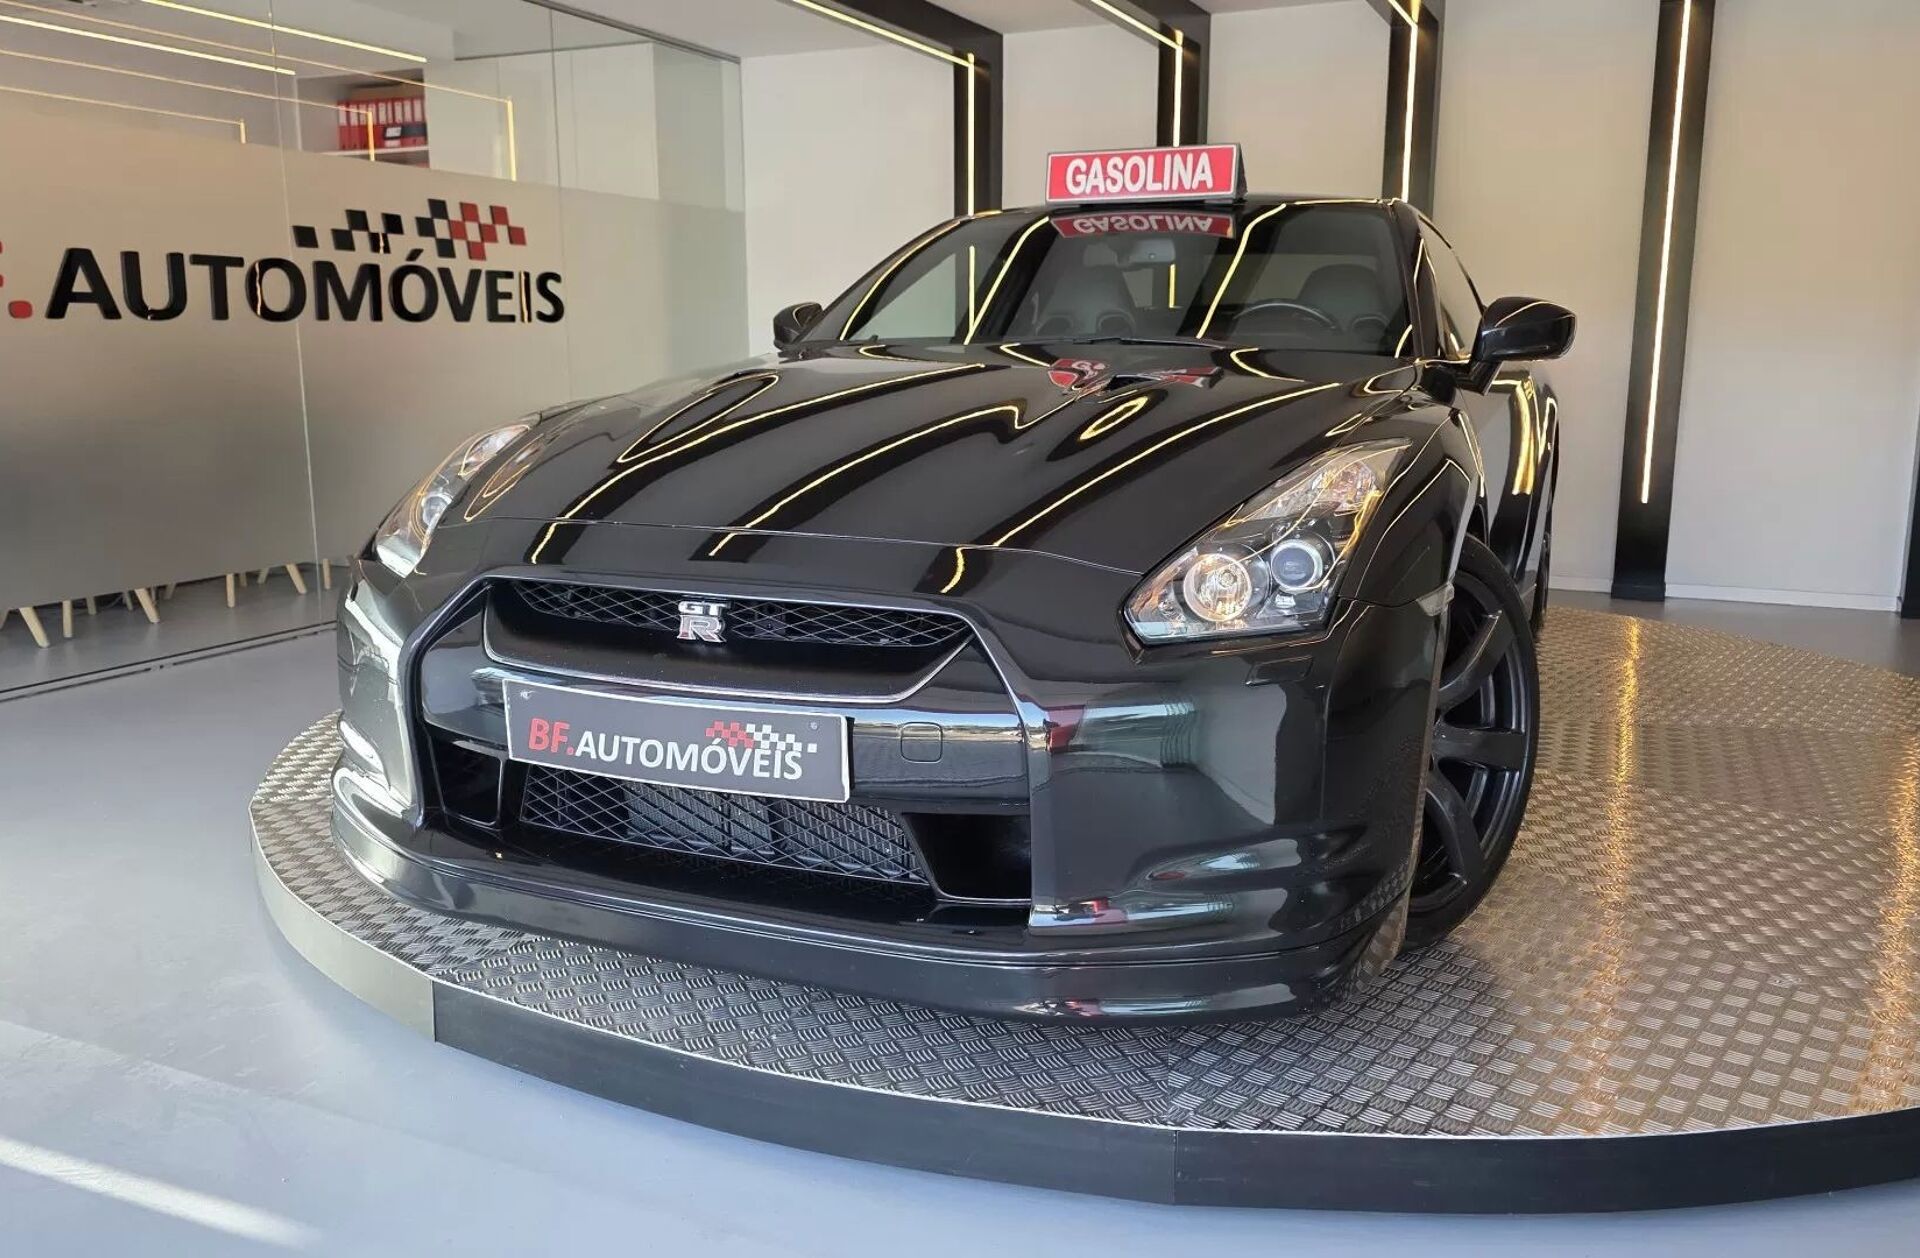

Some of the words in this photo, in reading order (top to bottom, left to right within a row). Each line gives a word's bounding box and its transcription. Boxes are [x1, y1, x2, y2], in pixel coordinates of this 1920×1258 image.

[1065, 152, 1214, 195] GASOLINA
[0, 241, 565, 323] .AUTOMÓVEIS
[676, 614, 727, 643] R
[677, 600, 728, 616] GT
[528, 717, 803, 781] BF.AUTOMÓVEIS
